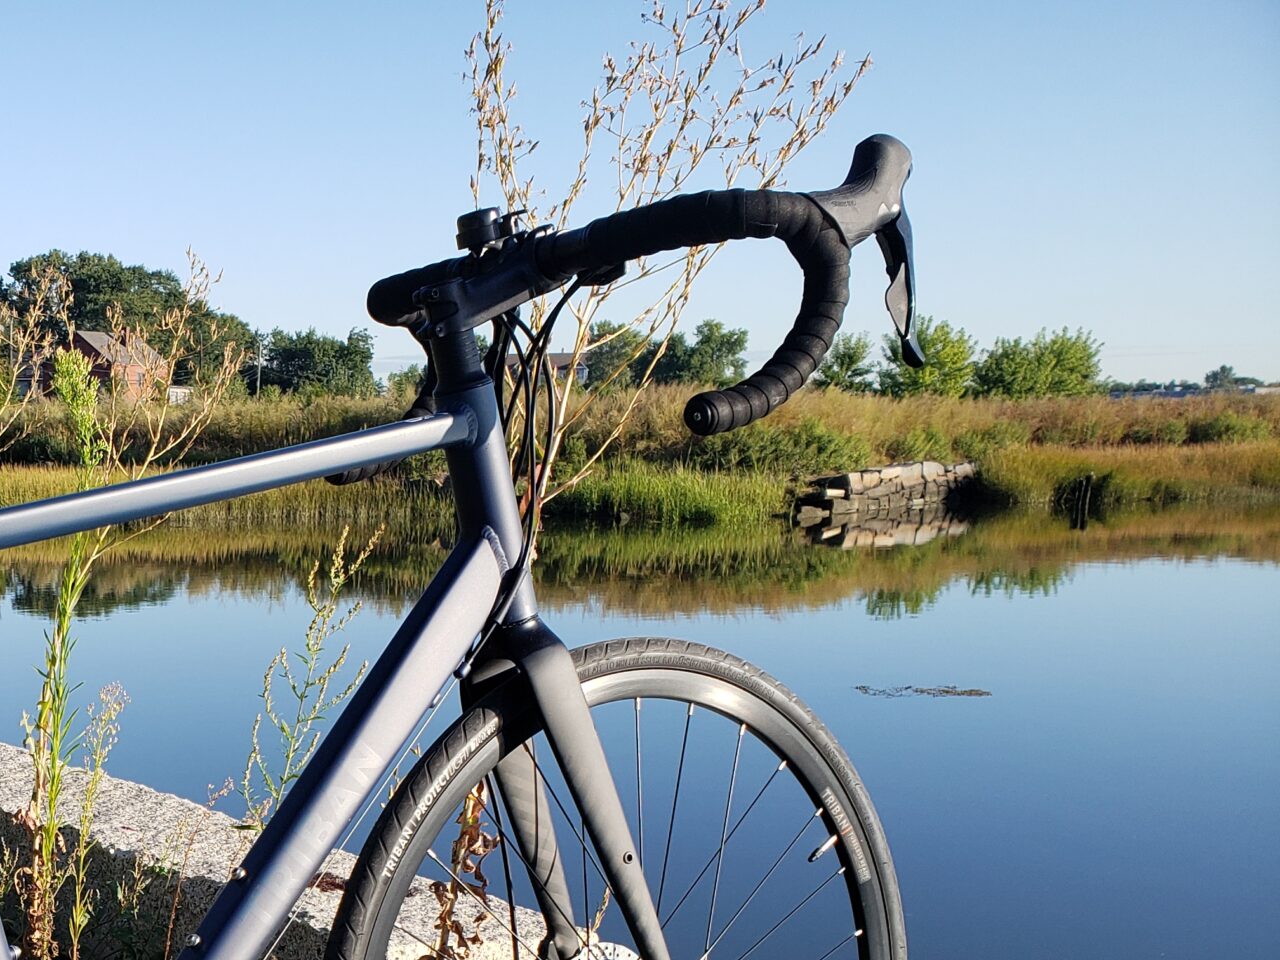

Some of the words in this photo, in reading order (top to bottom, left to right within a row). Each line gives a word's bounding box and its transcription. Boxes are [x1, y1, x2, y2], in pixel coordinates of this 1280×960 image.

[245, 740, 384, 921] TRIBAN
[822, 789, 849, 831] TRIBAN
[382, 828, 413, 878] TRIBAN
